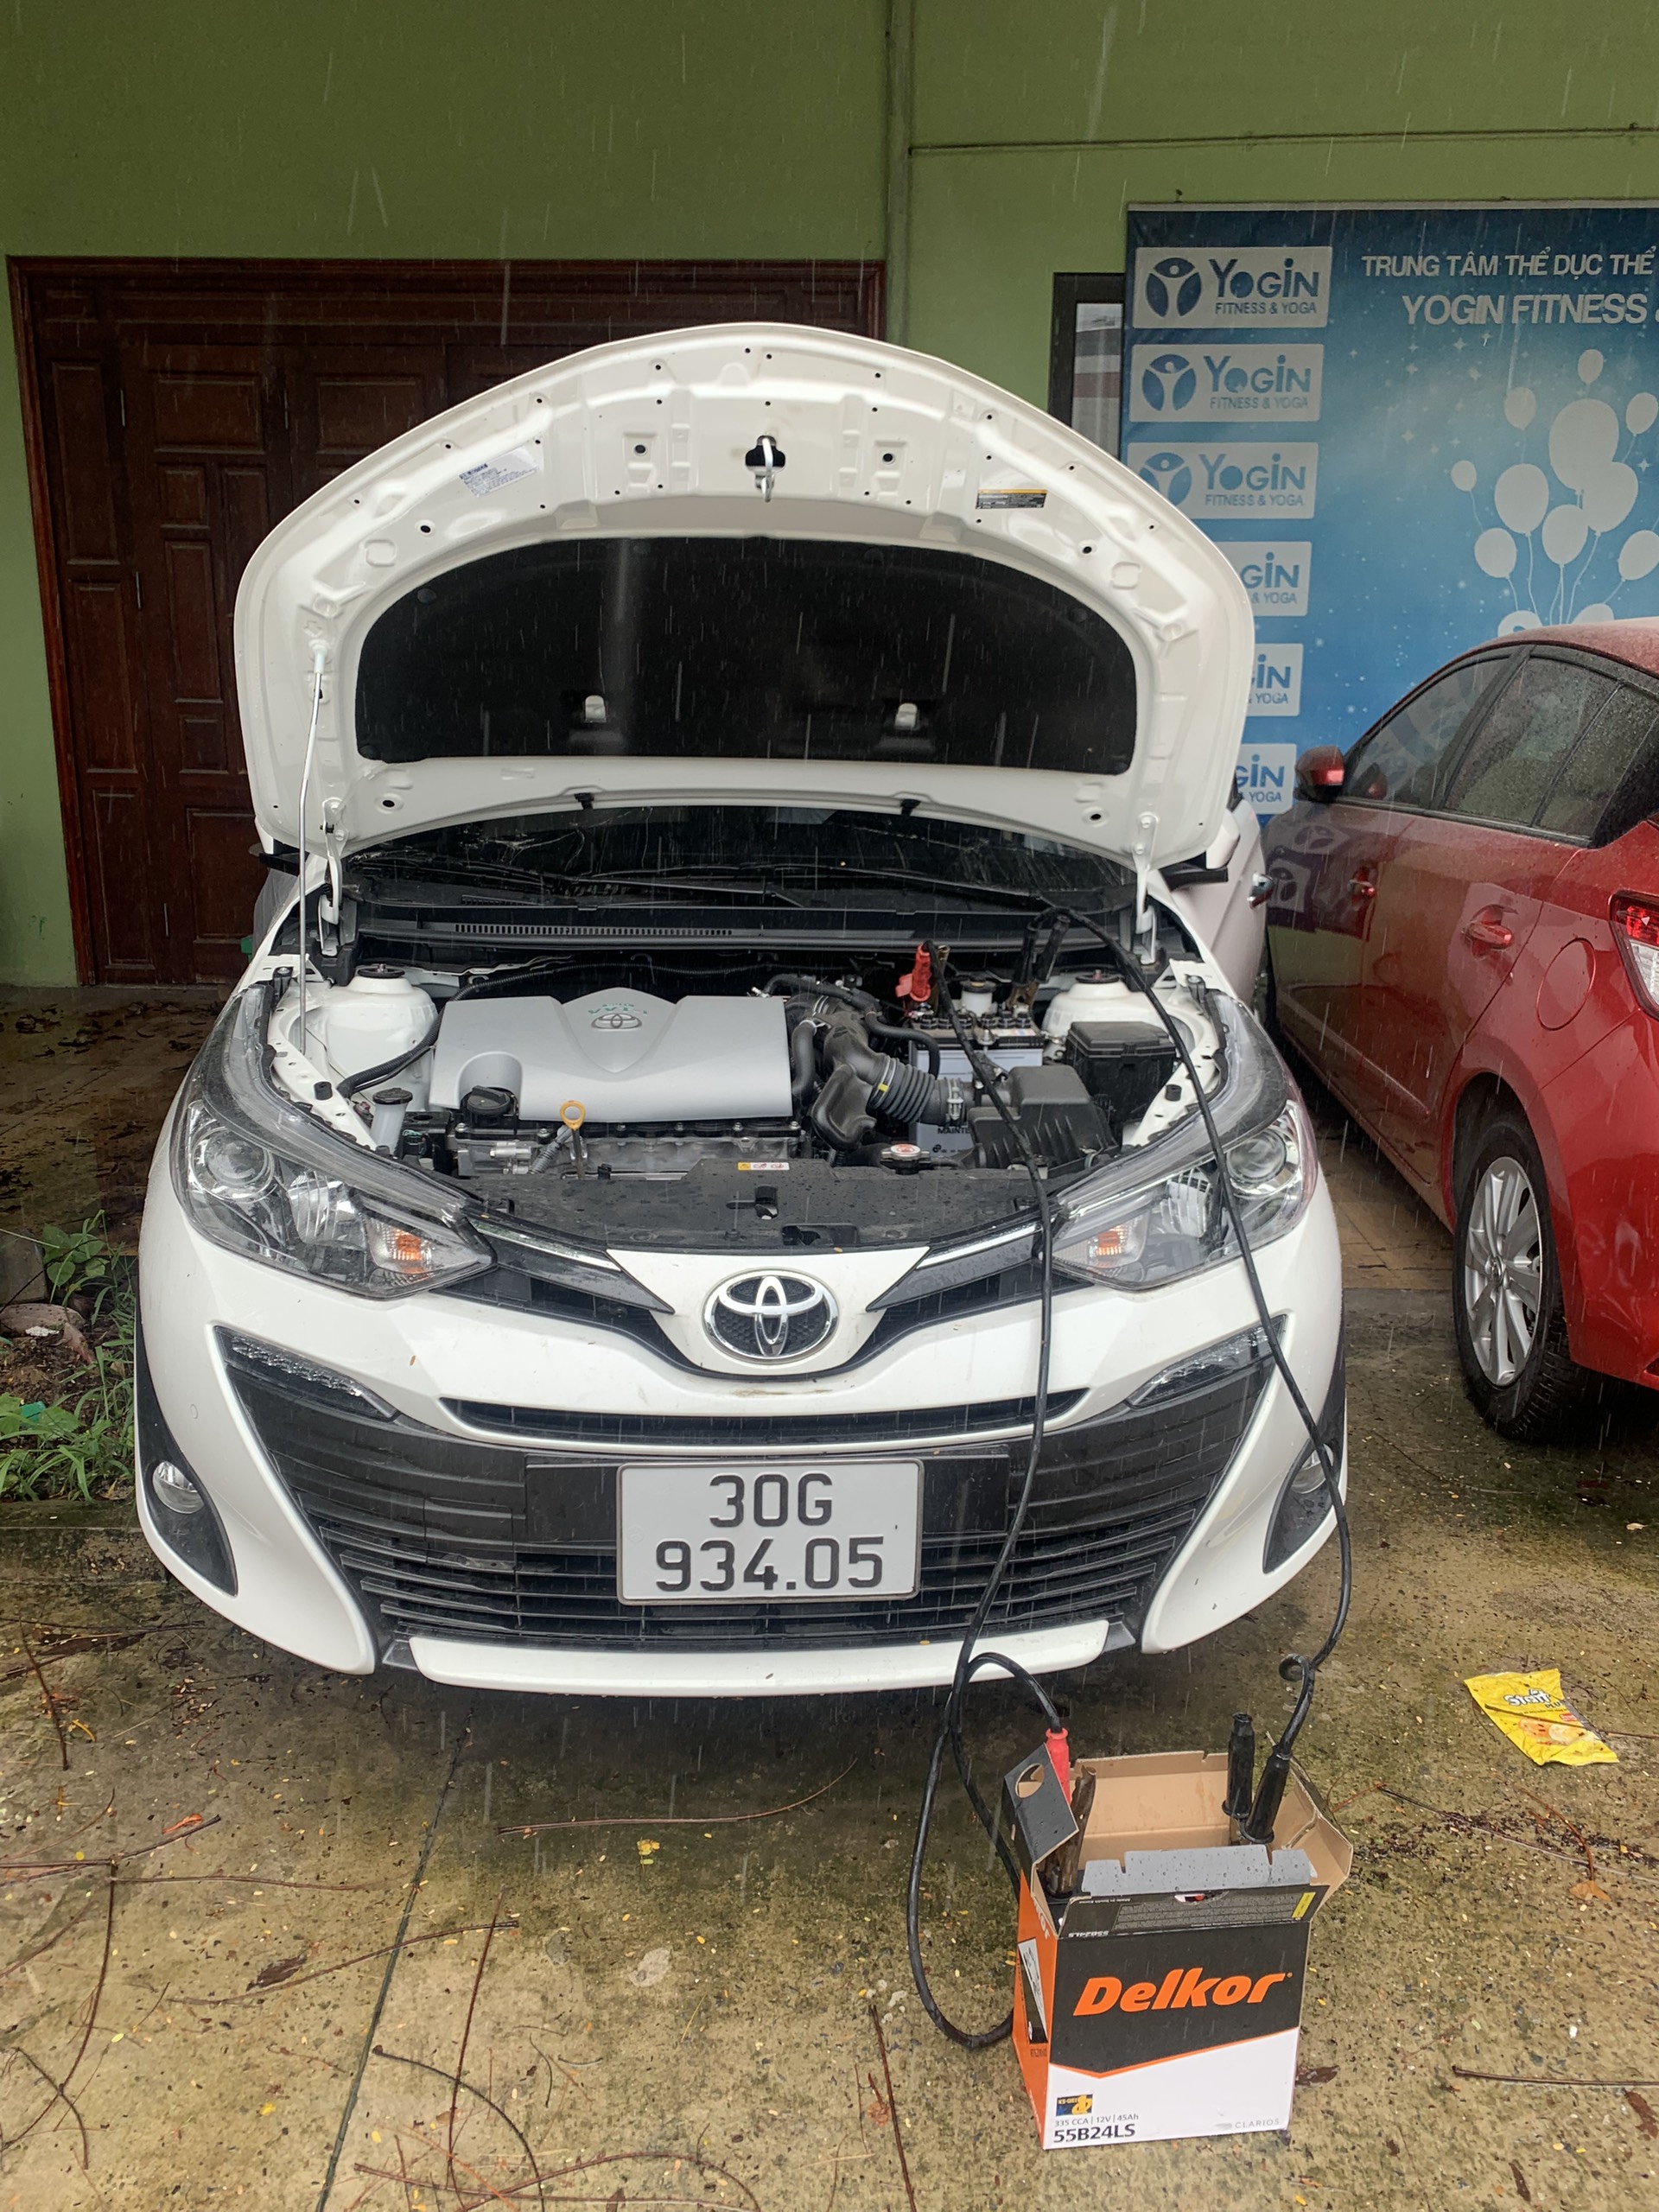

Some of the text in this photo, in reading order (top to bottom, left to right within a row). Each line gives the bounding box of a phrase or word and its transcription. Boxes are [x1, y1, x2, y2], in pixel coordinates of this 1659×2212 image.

[1361, 245, 1656, 280] TRUNG TÂM THỂ DỤC THỂ
[1215, 302, 1317, 314] FITNESS & YOGA
[1402, 294, 1505, 325] YOGIN
[1512, 293, 1648, 324] FITNESS
[1211, 397, 1309, 409] FITNESS & YOGA
[1205, 494, 1304, 506] FITNESS & YOGA
[1263, 592, 1298, 604] YOGA
[1255, 692, 1289, 704] YOGA
[1249, 791, 1283, 803] YOGA
[709, 1472, 833, 1528] 30G
[655, 1535, 884, 1592] 934.05
[1073, 1967, 1286, 2016] Delkor
[1117, 2113, 1139, 2121] 45Ah
[1234, 2118, 1280, 2129] CLARIOS
[1053, 2123, 1136, 2143] 55B24LS
